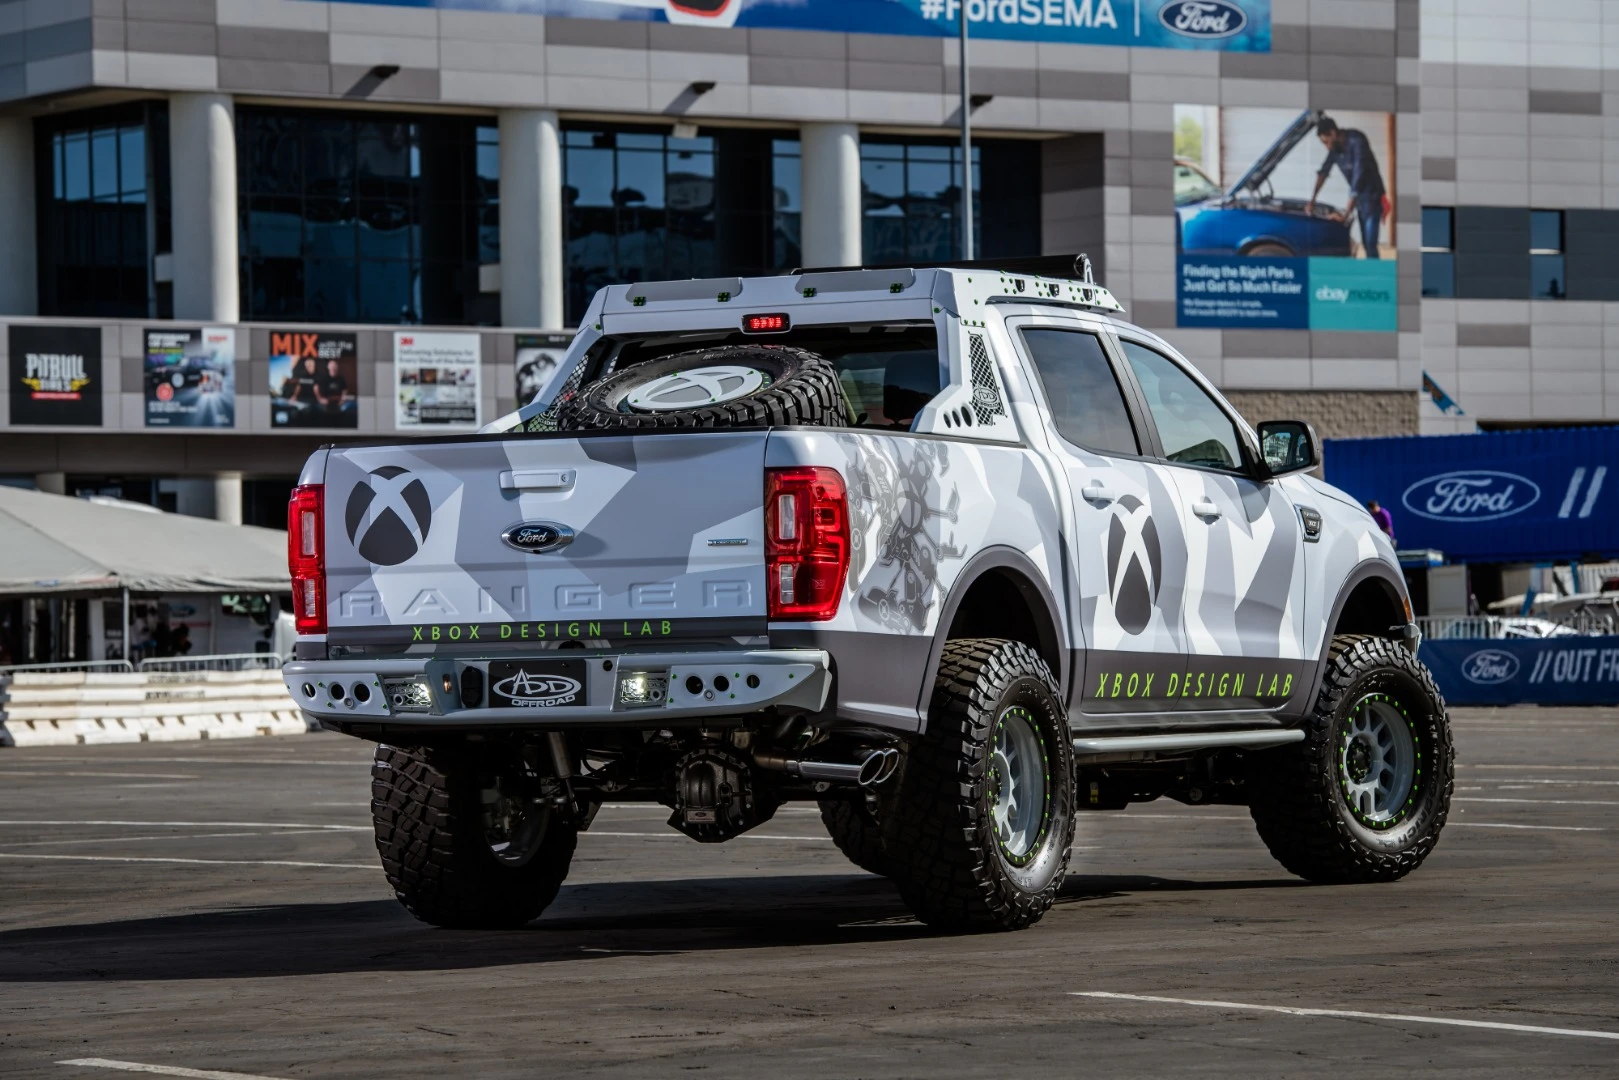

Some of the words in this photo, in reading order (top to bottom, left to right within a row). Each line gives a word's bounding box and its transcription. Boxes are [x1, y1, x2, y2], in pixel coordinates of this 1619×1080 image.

[921, 0, 1118, 29] #FordSEMA
[1175, 0, 1231, 33] Ford
[1183, 264, 1220, 280] Finding
[1221, 265, 1238, 278] the
[1239, 265, 1266, 280] Right
[1267, 265, 1294, 280] Parts
[1183, 278, 1205, 293] Just
[1206, 279, 1226, 293] Got
[1227, 279, 1241, 293] So
[1242, 280, 1271, 294] Much
[1271, 280, 1302, 295] Easier
[272, 333, 318, 358] MIX
[400, 337, 414, 345] 3M
[318, 348, 342, 359] BEST
[1426, 478, 1515, 514] Ford
[517, 528, 548, 544] Ford
[339, 579, 753, 619] RANGER
[413, 624, 480, 641] XBOX
[500, 621, 601, 639] DESIGN
[623, 619, 673, 637] LAB
[1470, 652, 1510, 679] Ford
[1095, 672, 1155, 698] XBOX
[1166, 672, 1245, 697] DESIGN
[1255, 673, 1293, 697] LAB
[511, 694, 576, 708] OFFROAD
